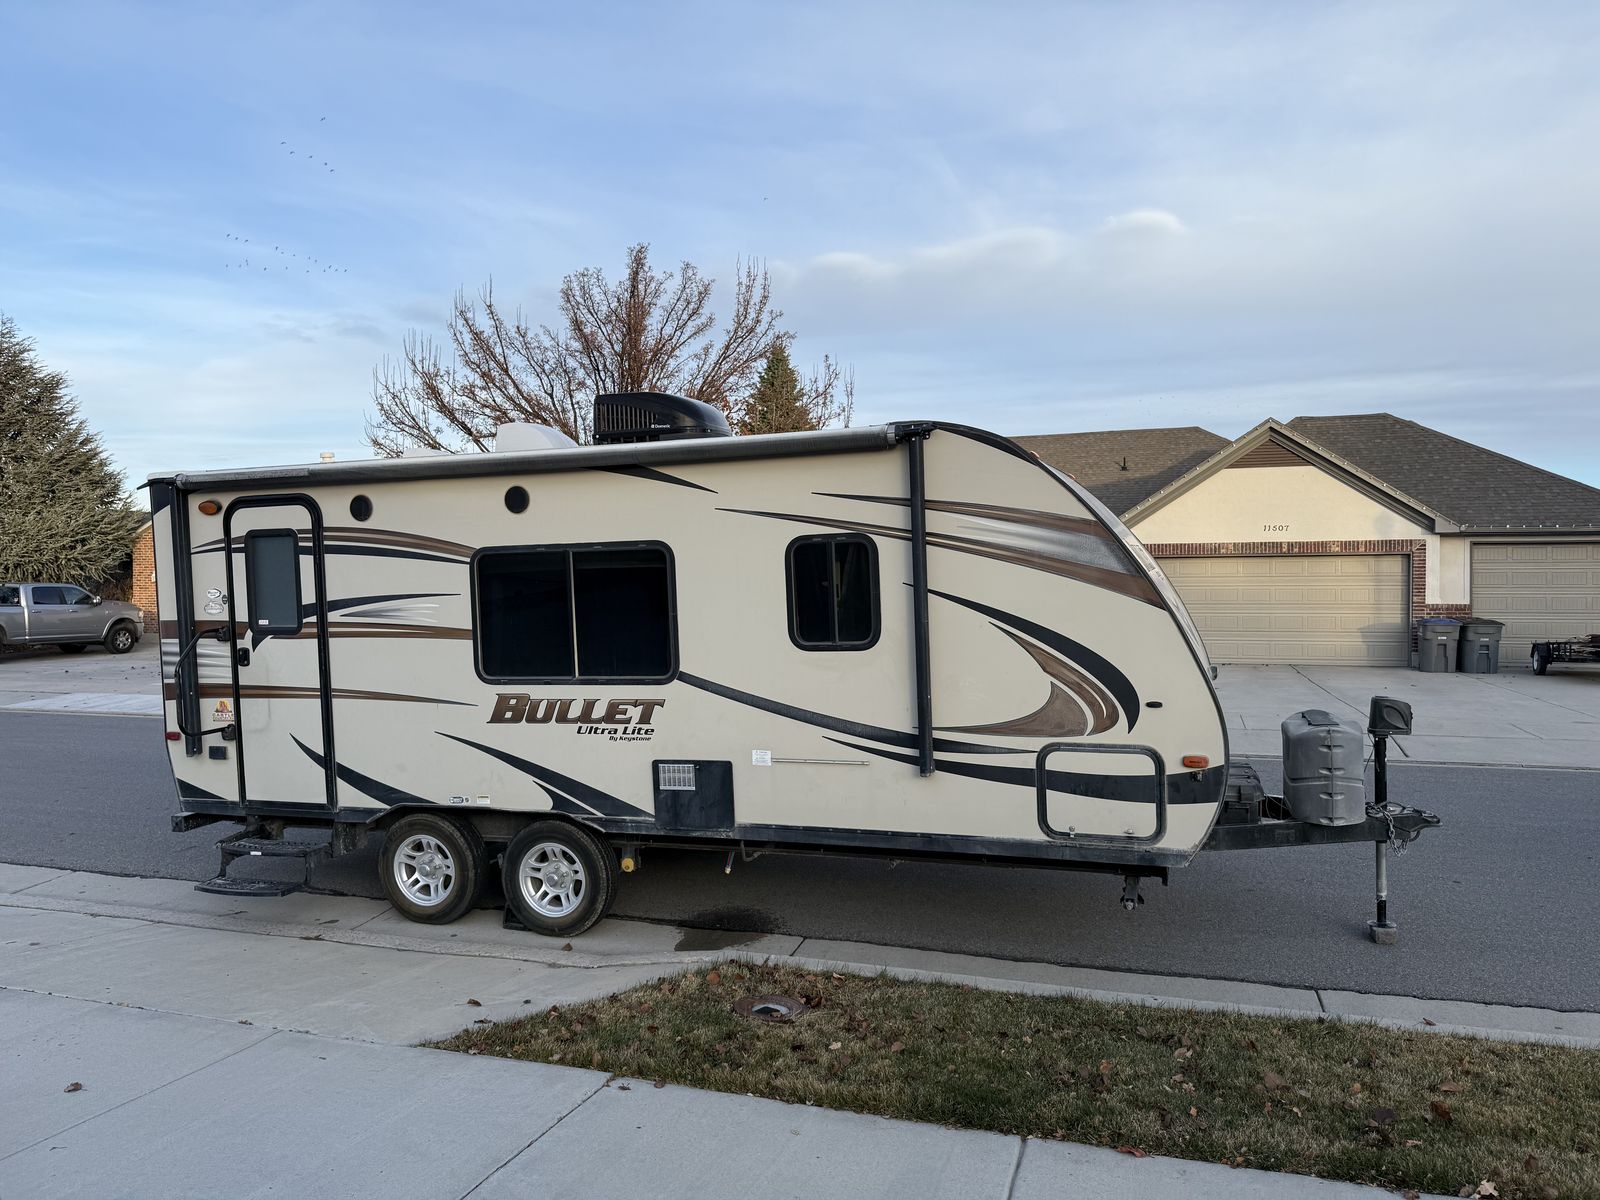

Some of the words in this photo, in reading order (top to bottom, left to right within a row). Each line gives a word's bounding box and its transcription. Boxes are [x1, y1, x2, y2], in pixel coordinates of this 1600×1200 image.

[1263, 524, 1289, 532] 11507
[487, 693, 666, 724] BULLET
[577, 726, 618, 735] Ultra
[622, 726, 655, 735] Lite
